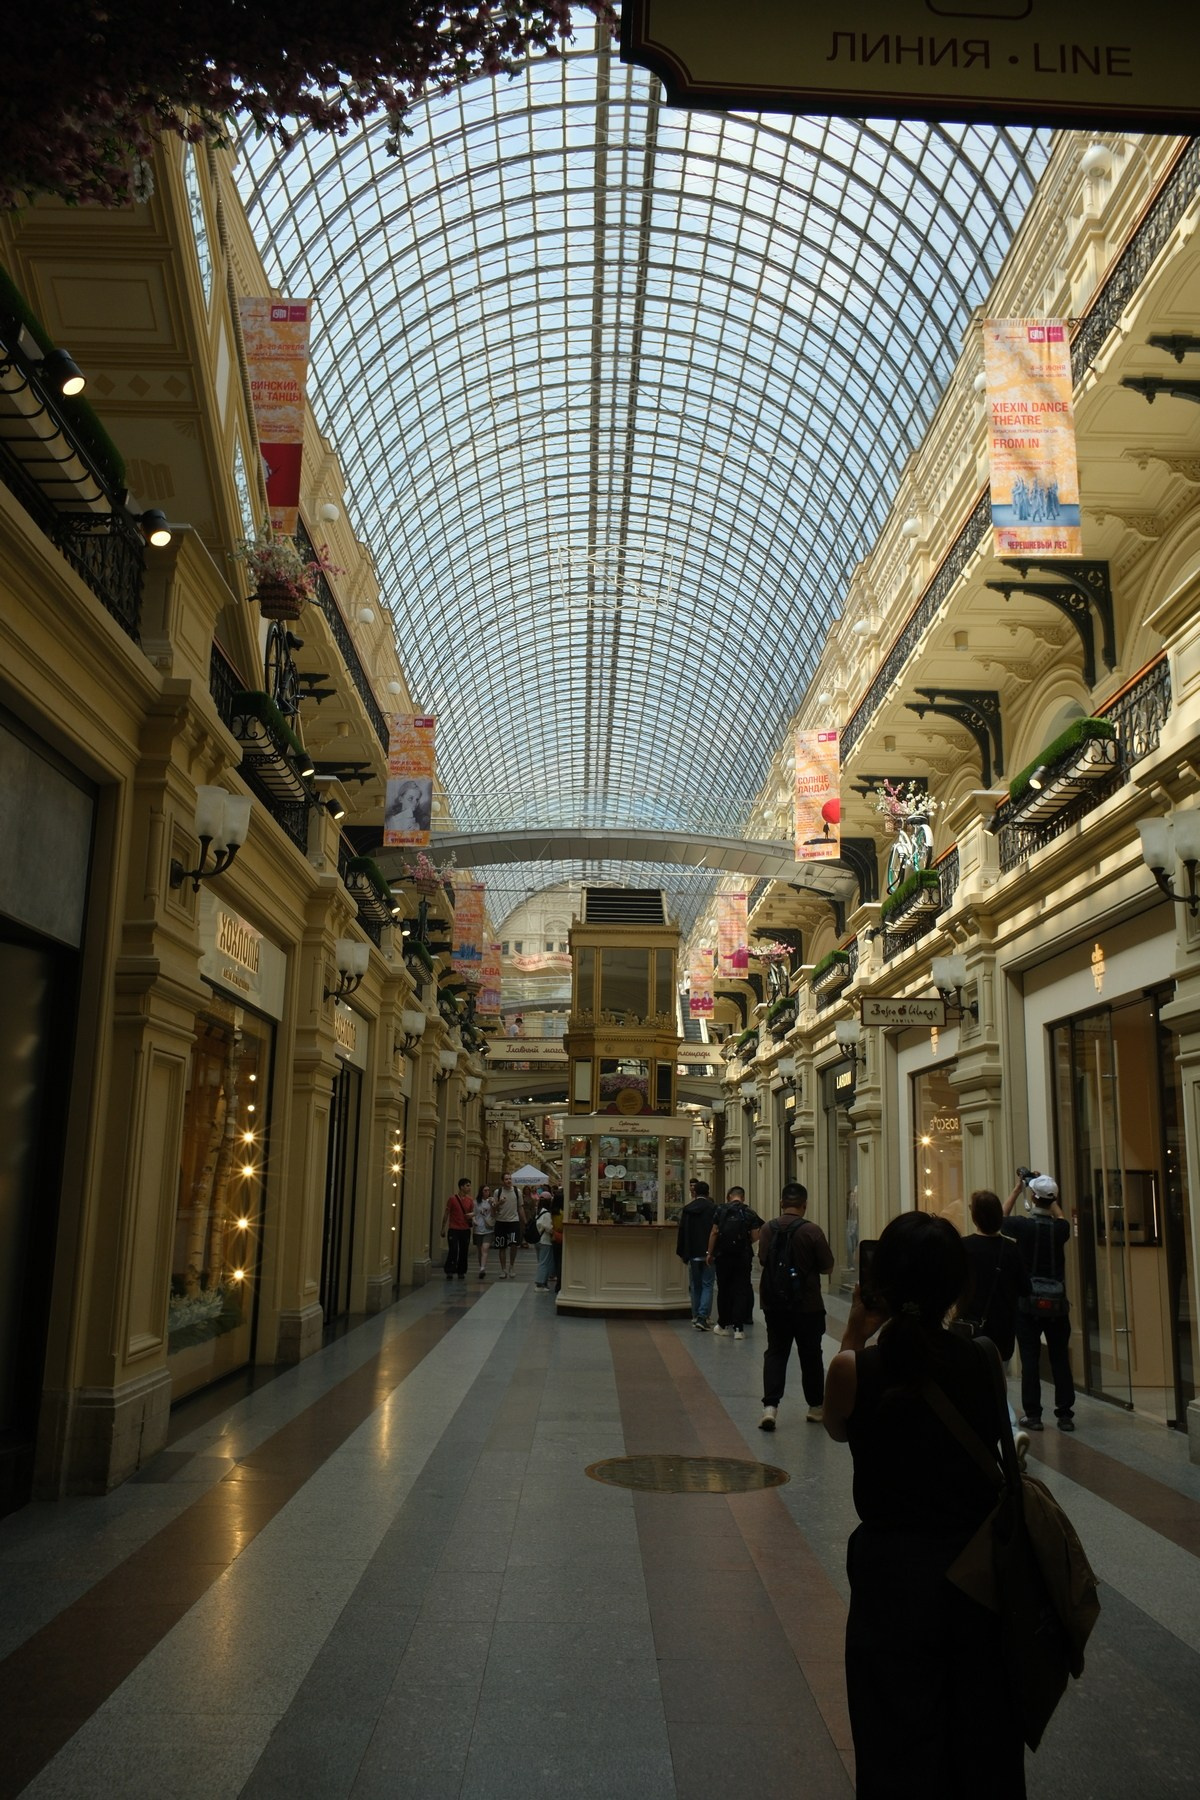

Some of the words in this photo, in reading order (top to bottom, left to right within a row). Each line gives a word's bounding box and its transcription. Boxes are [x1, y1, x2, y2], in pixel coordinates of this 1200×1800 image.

[826, 31, 990, 69] ЛИНИЯ
[1034, 43, 1132, 77] LINE
[267, 392, 302, 402] ТАНЦЫ
[992, 402, 1028, 413] XIEXIN
[1031, 402, 1068, 413] DANCE
[993, 415, 1041, 425] THEATRE
[994, 438, 1025, 449] FROM
[1028, 438, 1039, 448] IN
[1007, 541, 1052, 550] ЧЕРЕШНЕВЫЙ
[1054, 541, 1067, 549] ЛЕС
[798, 774, 829, 785] СОЛНЦЕ
[798, 784, 830, 794] ЛАНДАУ
[218, 912, 260, 974] ХОХЛОМА
[506, 1044, 539, 1054] Главный
